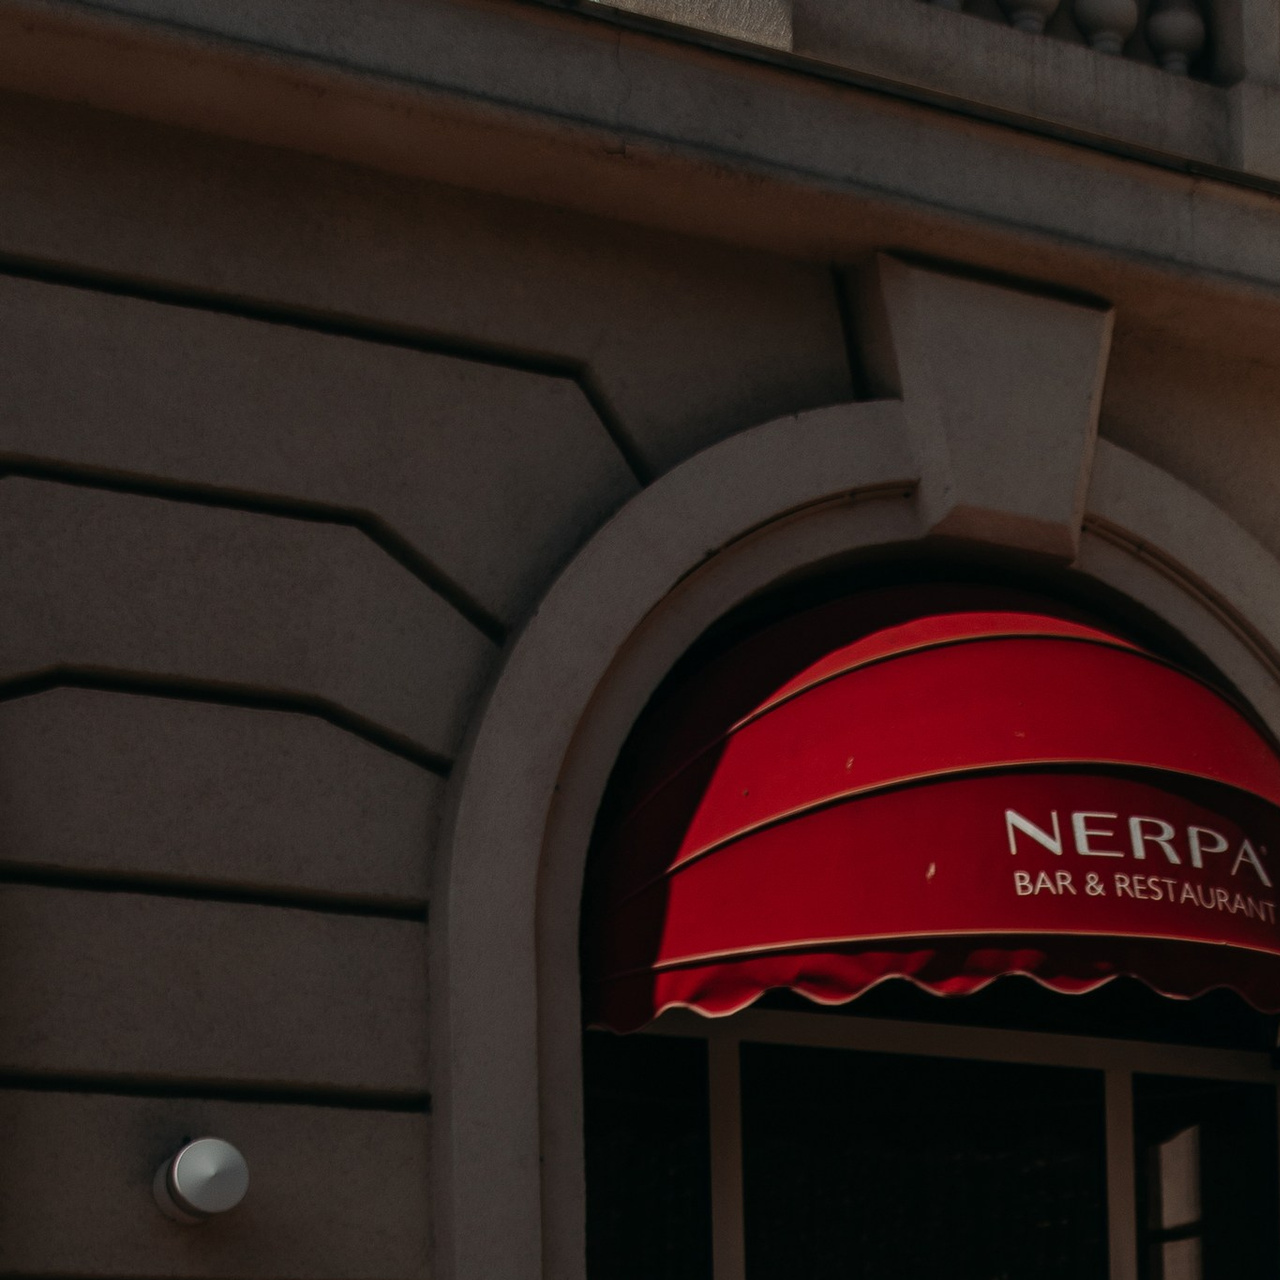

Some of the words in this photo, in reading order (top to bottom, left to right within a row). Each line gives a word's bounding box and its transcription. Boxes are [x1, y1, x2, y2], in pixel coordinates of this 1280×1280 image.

[1005, 808, 1272, 887] NERPA
[1013, 870, 1077, 896] BAR
[1085, 871, 1106, 896] &
[1114, 872, 1276, 925] RESTAURANT
